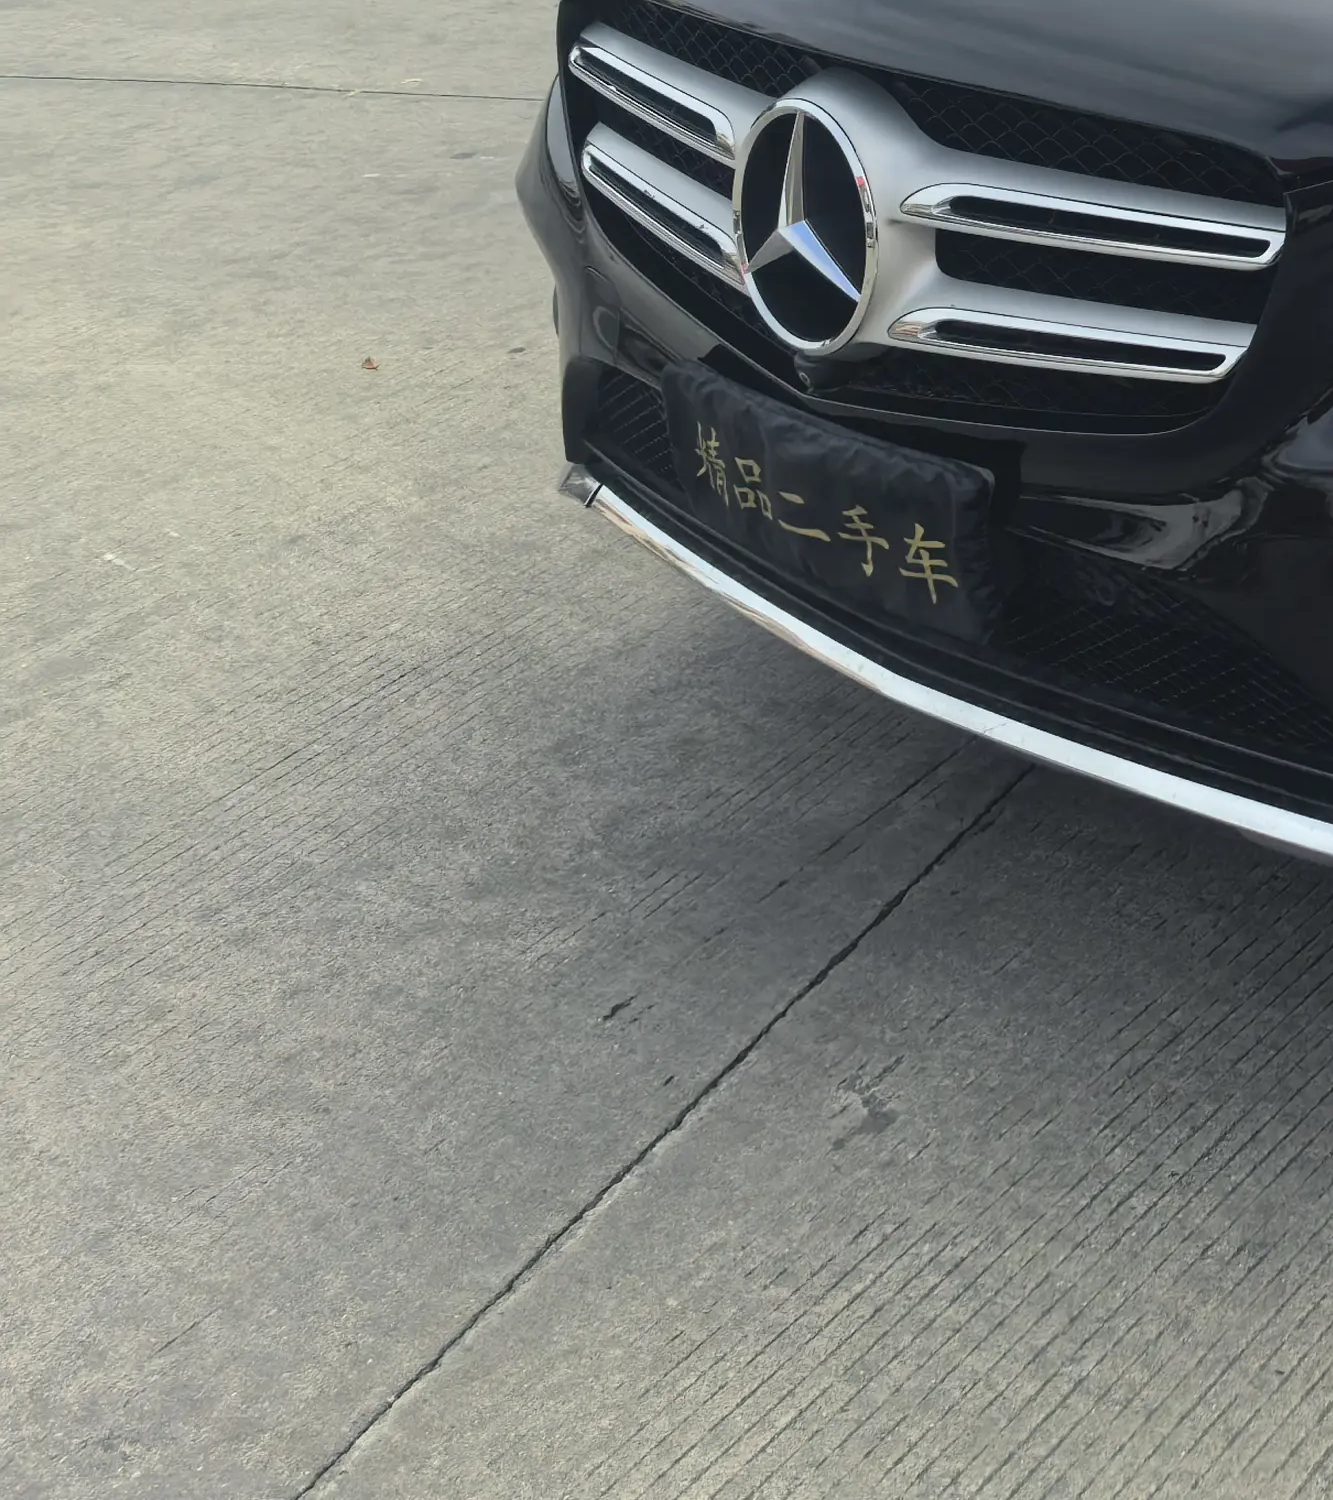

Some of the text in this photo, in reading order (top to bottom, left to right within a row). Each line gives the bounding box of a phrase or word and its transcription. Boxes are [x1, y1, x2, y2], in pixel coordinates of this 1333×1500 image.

[695, 421, 958, 604] 精品二手车
